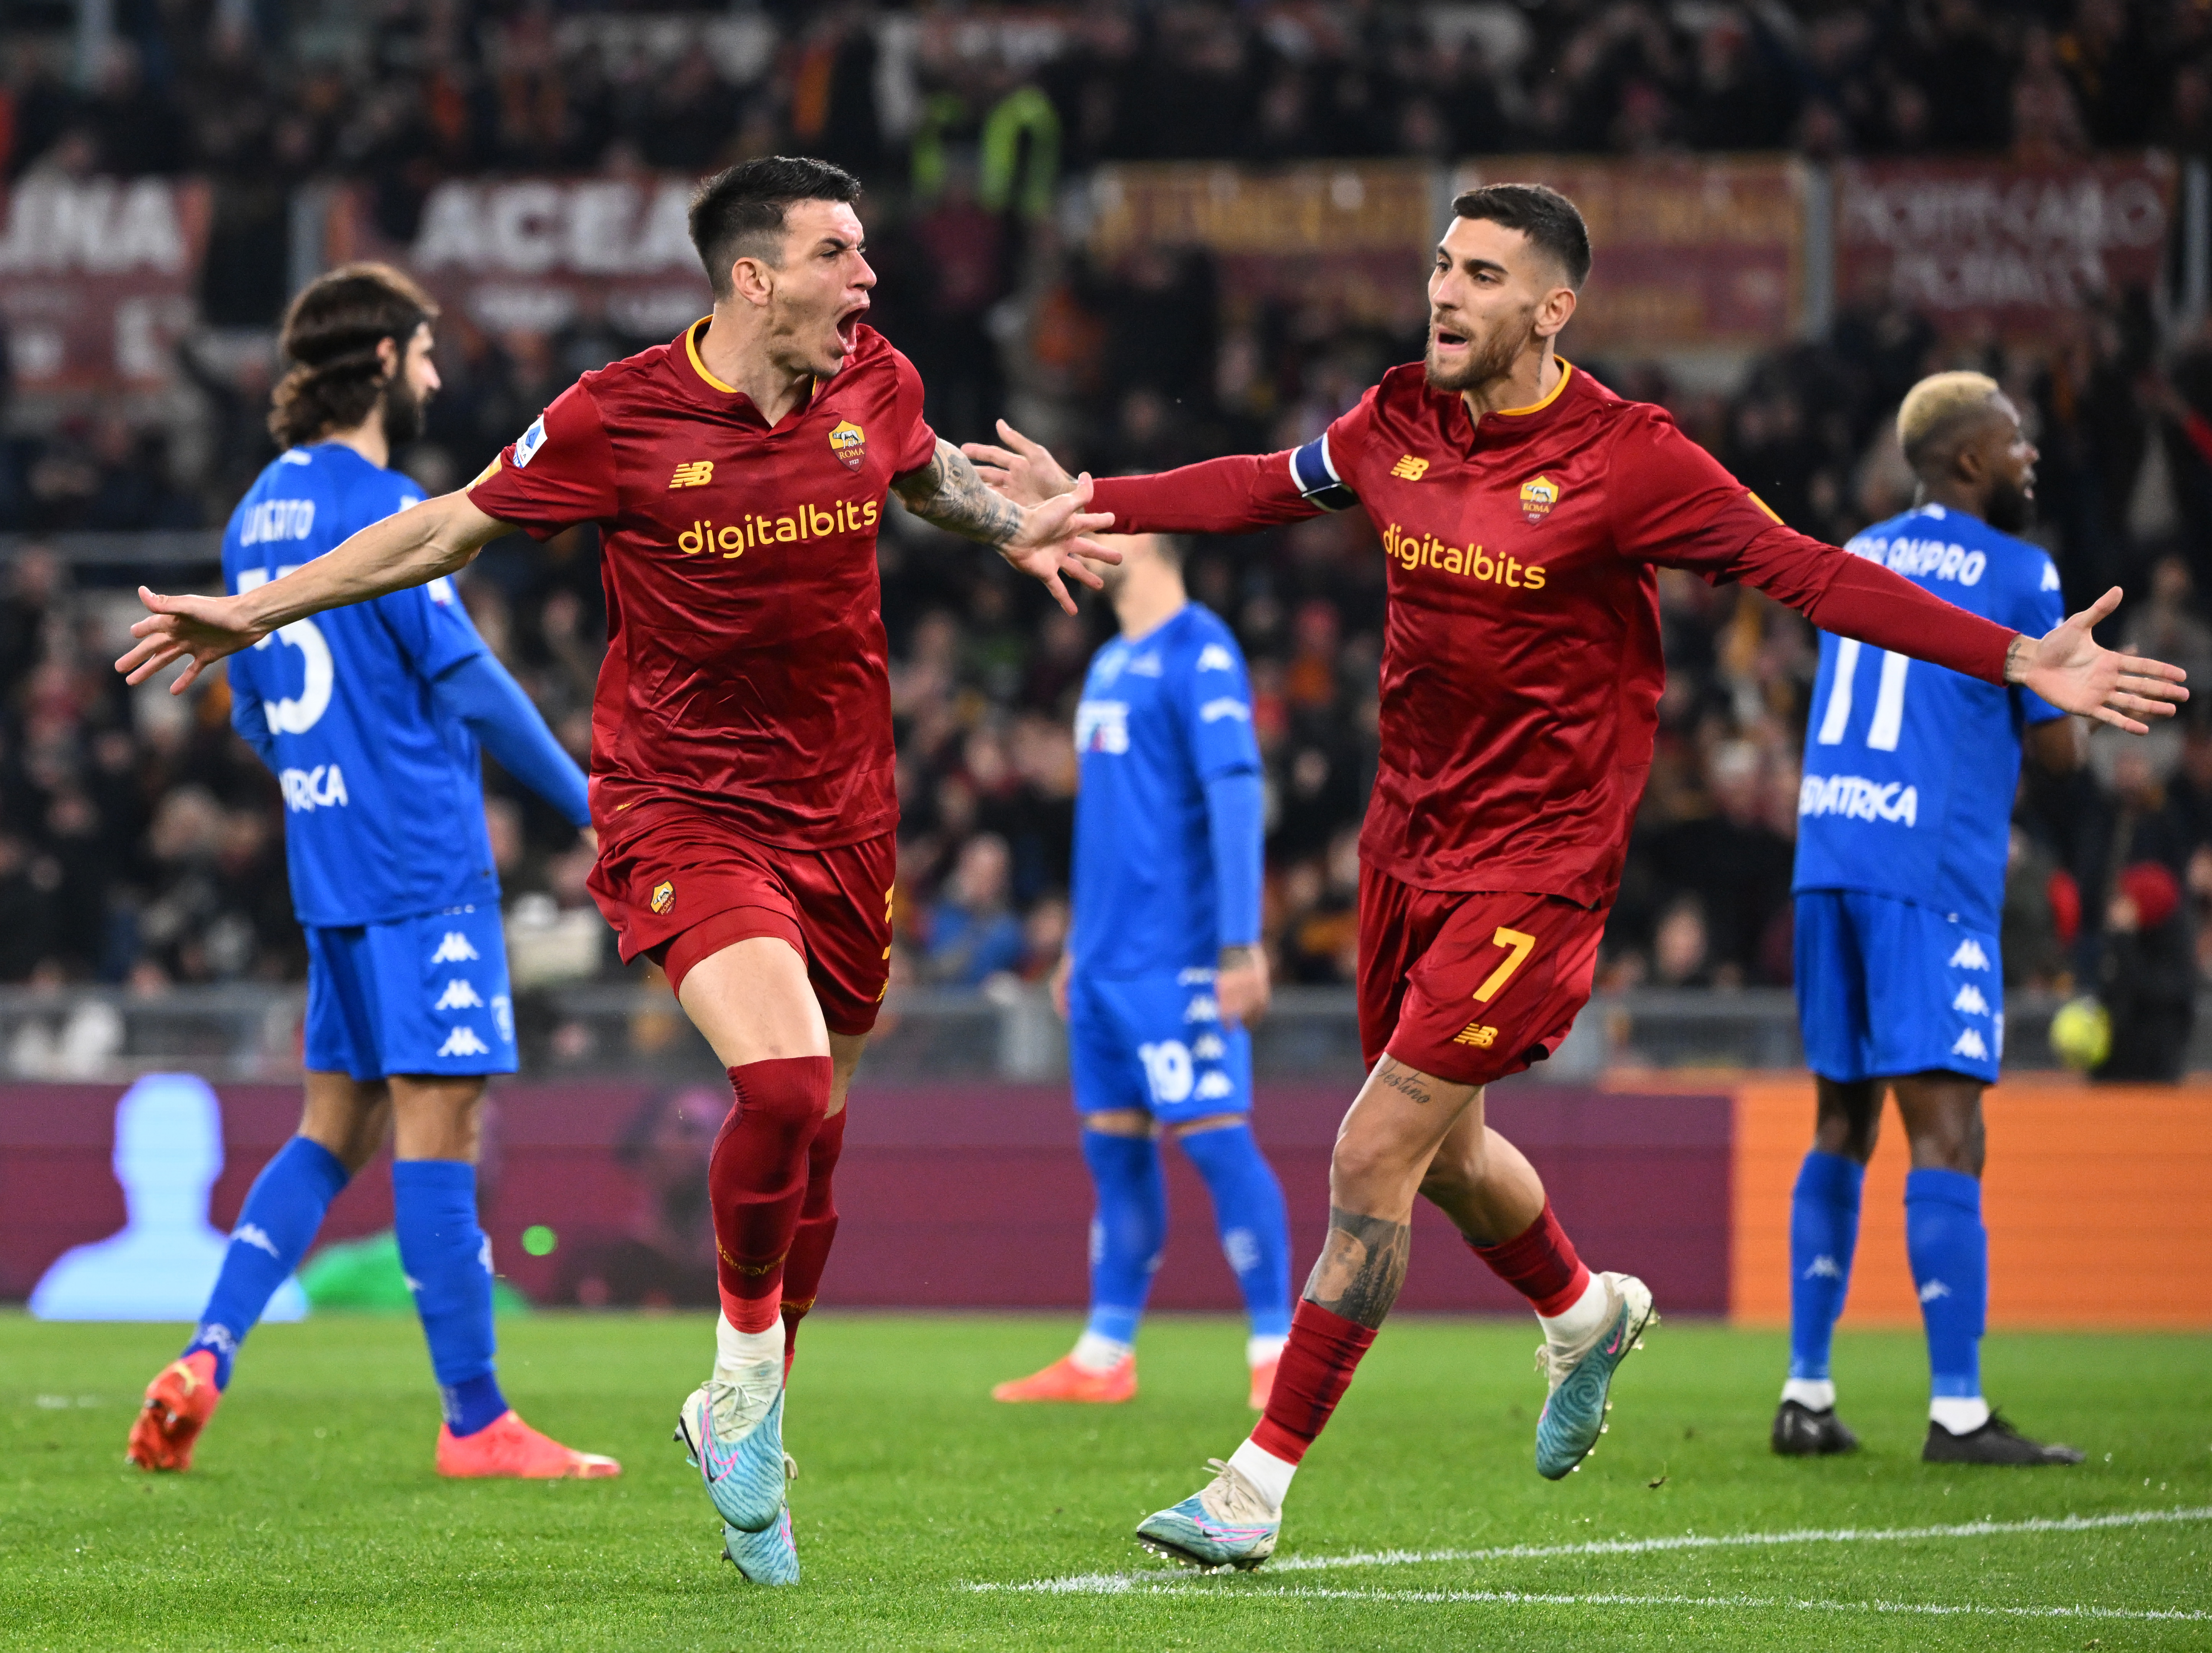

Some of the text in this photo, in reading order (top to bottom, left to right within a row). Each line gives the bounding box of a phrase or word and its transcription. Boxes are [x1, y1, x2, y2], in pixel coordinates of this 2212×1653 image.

[669, 461, 714, 488] NB
[839, 448, 865, 460] ROMA
[678, 500, 877, 558] digitalbits
[1523, 503, 1550, 513] ROMA
[1383, 523, 1546, 589] digitalbits
[660, 897, 674, 915] ROMA
[1473, 927, 1536, 1002] 7
[1137, 1040, 1195, 1106] 19
